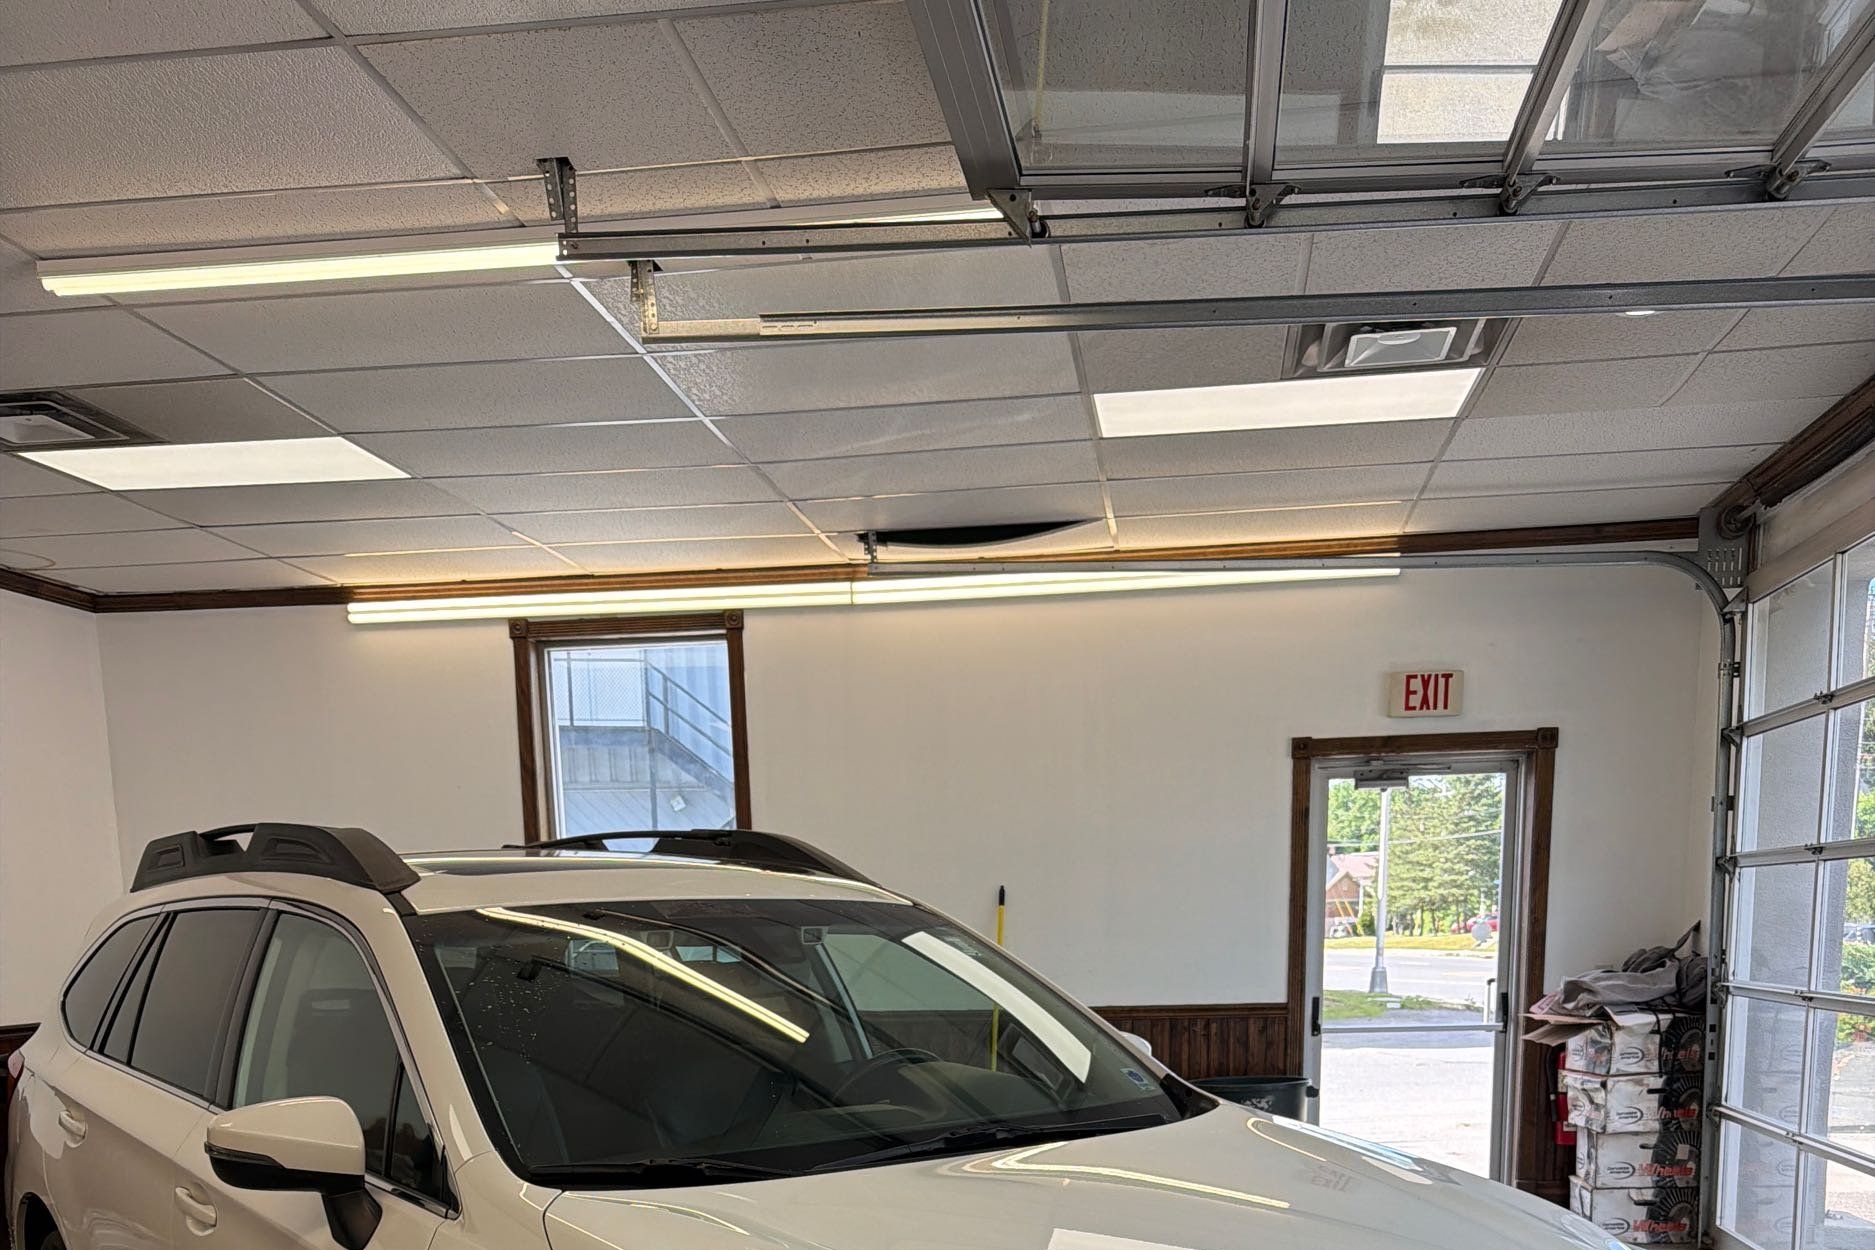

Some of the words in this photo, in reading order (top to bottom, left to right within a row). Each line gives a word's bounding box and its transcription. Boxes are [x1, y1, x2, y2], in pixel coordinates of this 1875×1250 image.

[1404, 673, 1453, 711] EXIT
[1639, 1163, 1693, 1176] Wheels
[1632, 1219, 1688, 1232] Wheels
